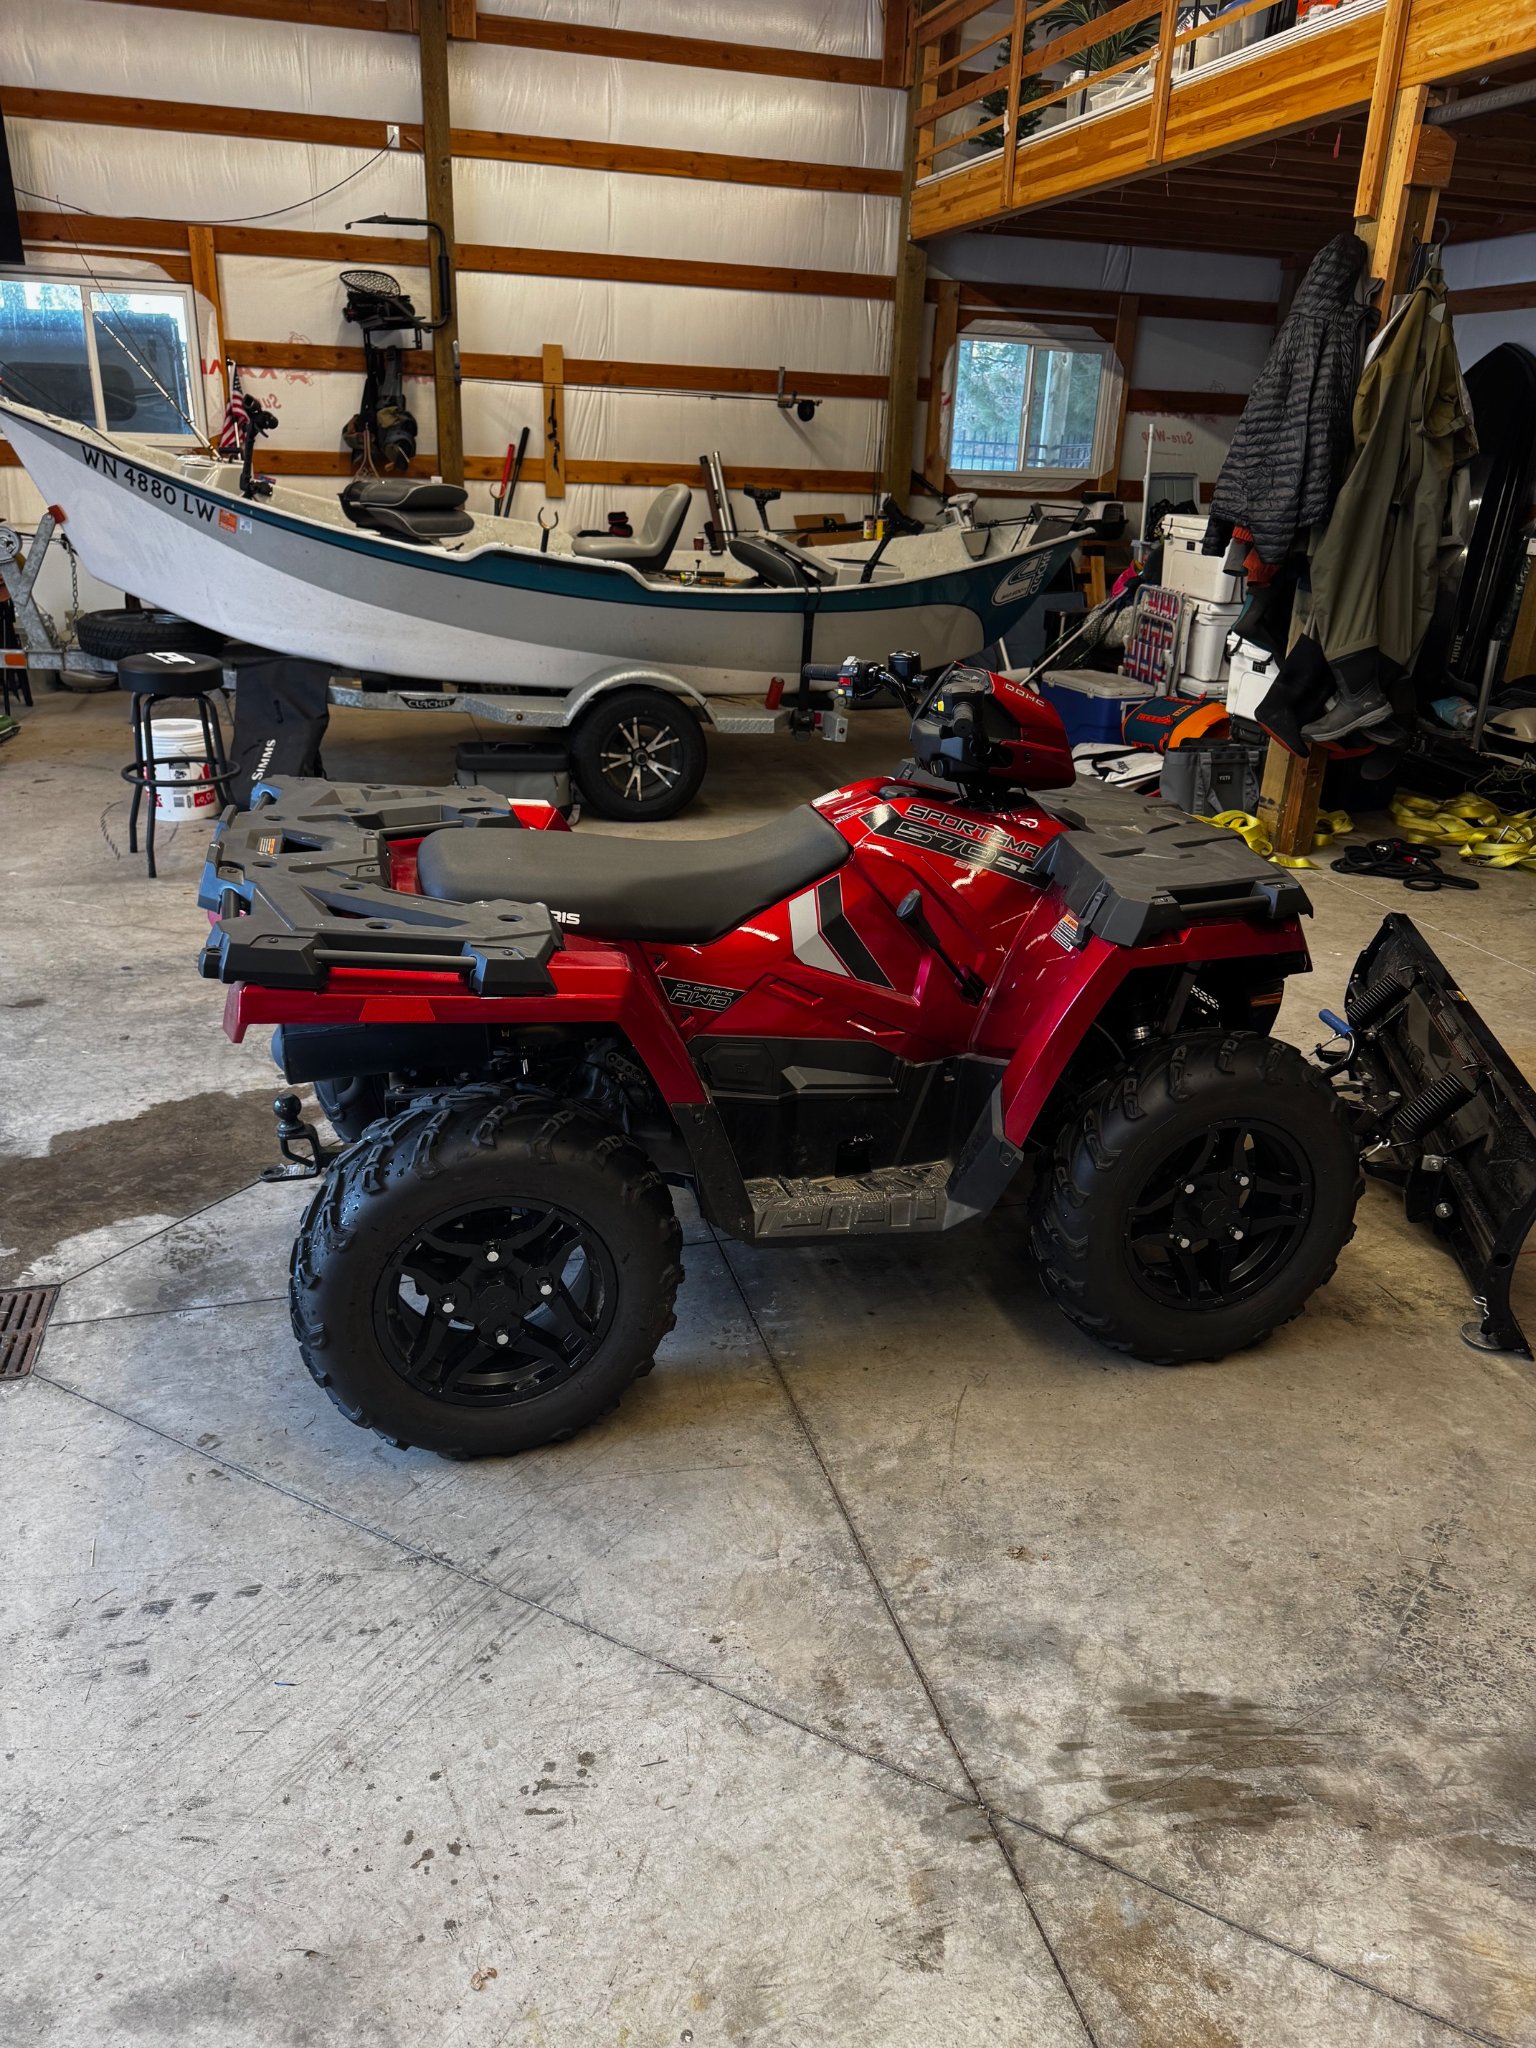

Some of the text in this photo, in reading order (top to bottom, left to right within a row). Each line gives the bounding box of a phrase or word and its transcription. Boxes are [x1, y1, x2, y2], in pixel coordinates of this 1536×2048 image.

[82, 445, 117, 479] WN
[124, 468, 176, 505] 4880
[183, 493, 216, 523] LW
[1450, 635, 1464, 663] THULE
[1004, 683, 1046, 707] DOHC
[251, 738, 276, 780] SIMMS
[894, 821, 998, 864] 570
[904, 803, 1043, 859] SPORTSMA
[550, 910, 580, 925] RIS
[669, 988, 732, 1009] AWD
